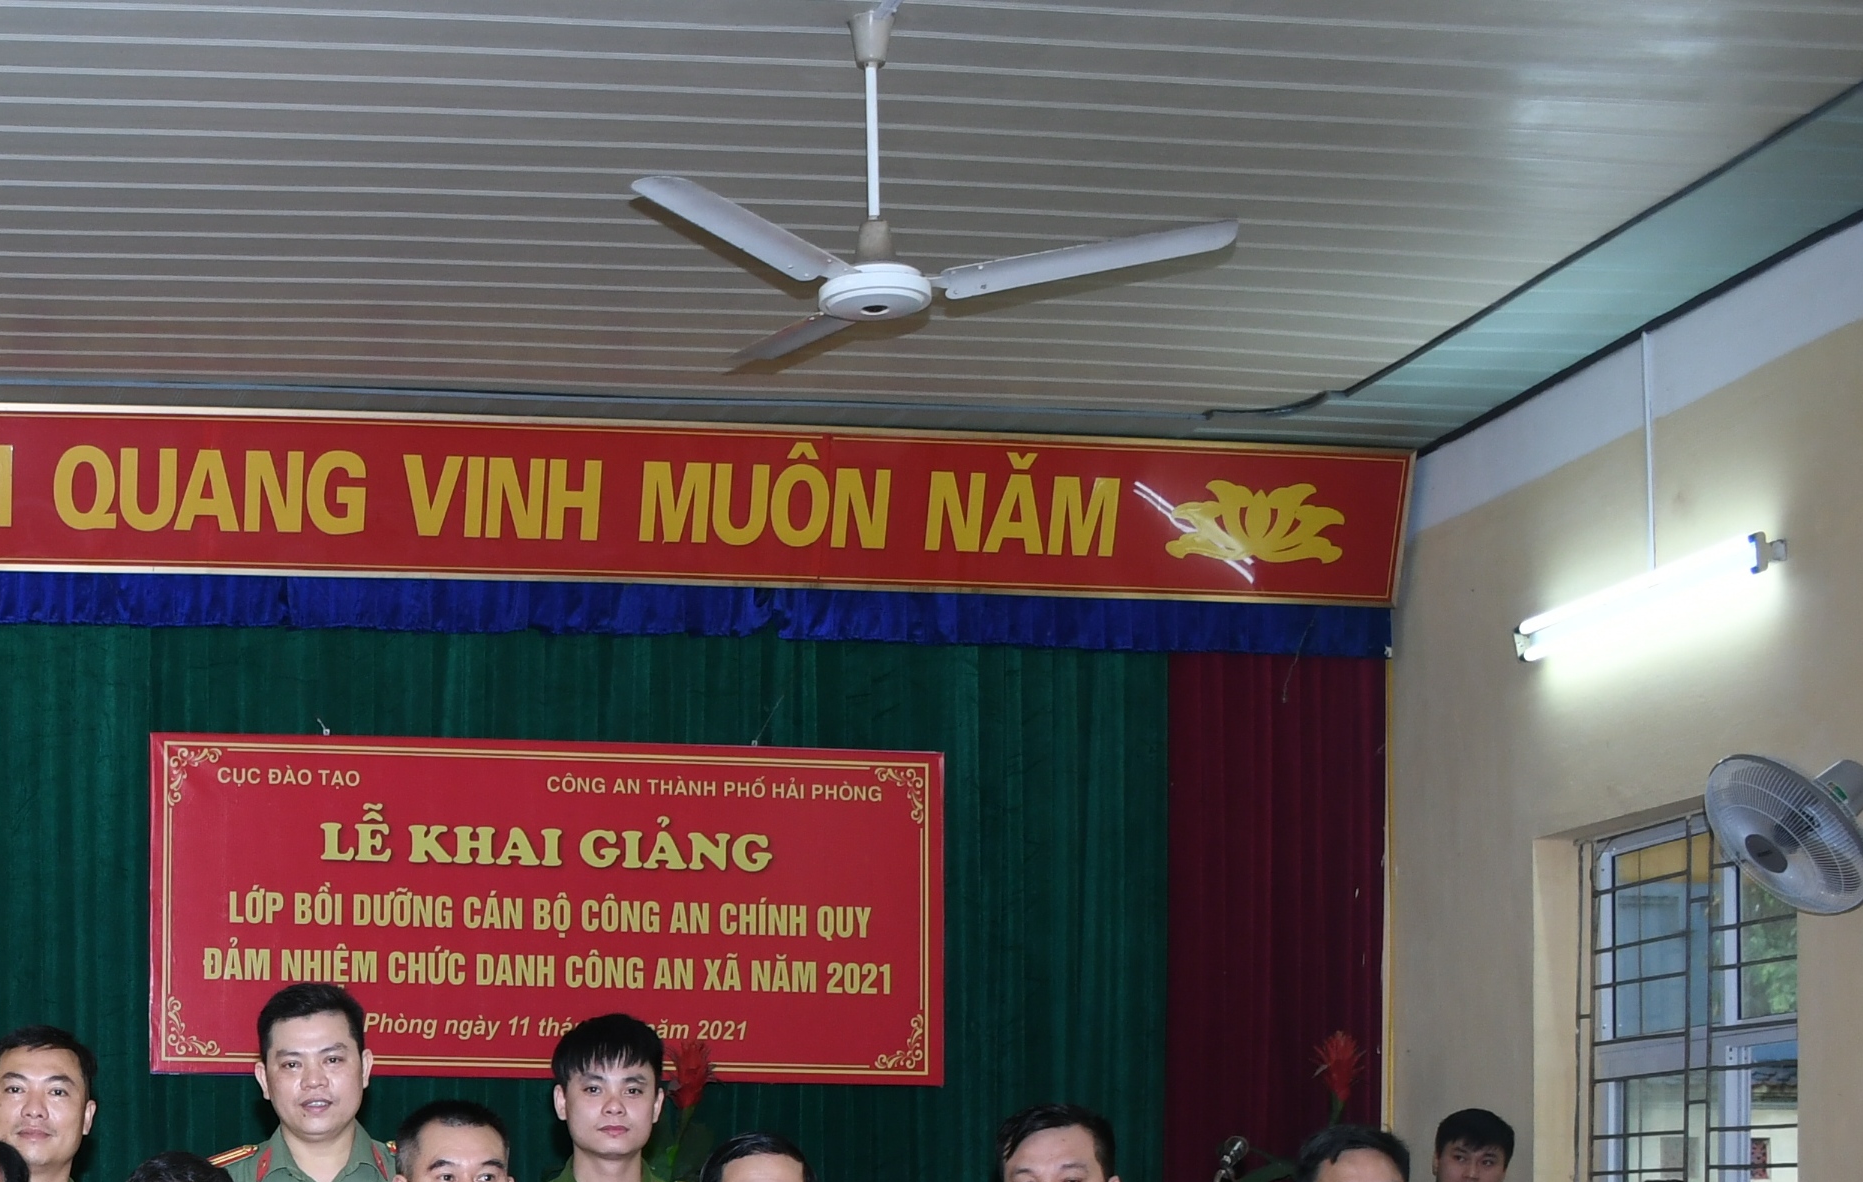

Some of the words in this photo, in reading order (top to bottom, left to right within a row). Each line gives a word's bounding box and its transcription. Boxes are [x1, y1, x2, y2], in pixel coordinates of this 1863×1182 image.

[53, 445, 367, 535] QUANG
[403, 454, 603, 541] VINH
[639, 442, 892, 549] MUÔN
[925, 452, 1121, 557] NĂM
[217, 766, 261, 788] CỤC
[267, 765, 312, 786] ĐÀO
[318, 769, 360, 790] TẠO
[546, 773, 606, 794] CÔNG
[612, 779, 640, 794] AN
[647, 776, 716, 797] THÀNH
[723, 776, 766, 799] PHỐ
[772, 777, 805, 800] HẢI
[811, 781, 883, 802] PHÒNG
[320, 803, 392, 862] LỄ
[408, 824, 563, 867] KHAI
[579, 816, 773, 872] GIẢNG
[229, 885, 284, 924] LỚP
[294, 882, 343, 926] BỒI
[353, 886, 453, 929] DƯỠNG
[463, 890, 523, 930] CÁN
[533, 892, 571, 938] BỘ
[581, 894, 660, 933] CÔNG
[669, 902, 710, 934] AN
[719, 897, 807, 937] CHÍNH
[817, 905, 872, 941] QUY
[202, 937, 271, 981] ĐẢM
[280, 943, 378, 989] NHIỆM
[388, 945, 466, 986] CHỨC
[476, 953, 555, 987] DANH
[565, 949, 644, 989] CÔNG
[653, 957, 694, 990] AN
[703, 953, 742, 991] XÃ
[751, 954, 817, 993] NĂM
[826, 963, 891, 995] 2021
[363, 1012, 438, 1040] Phòng
[444, 1014, 501, 1041] ngày
[508, 1016, 530, 1037] 11
[538, 1016, 580, 1037] thá
[696, 1020, 747, 1041] 2021
